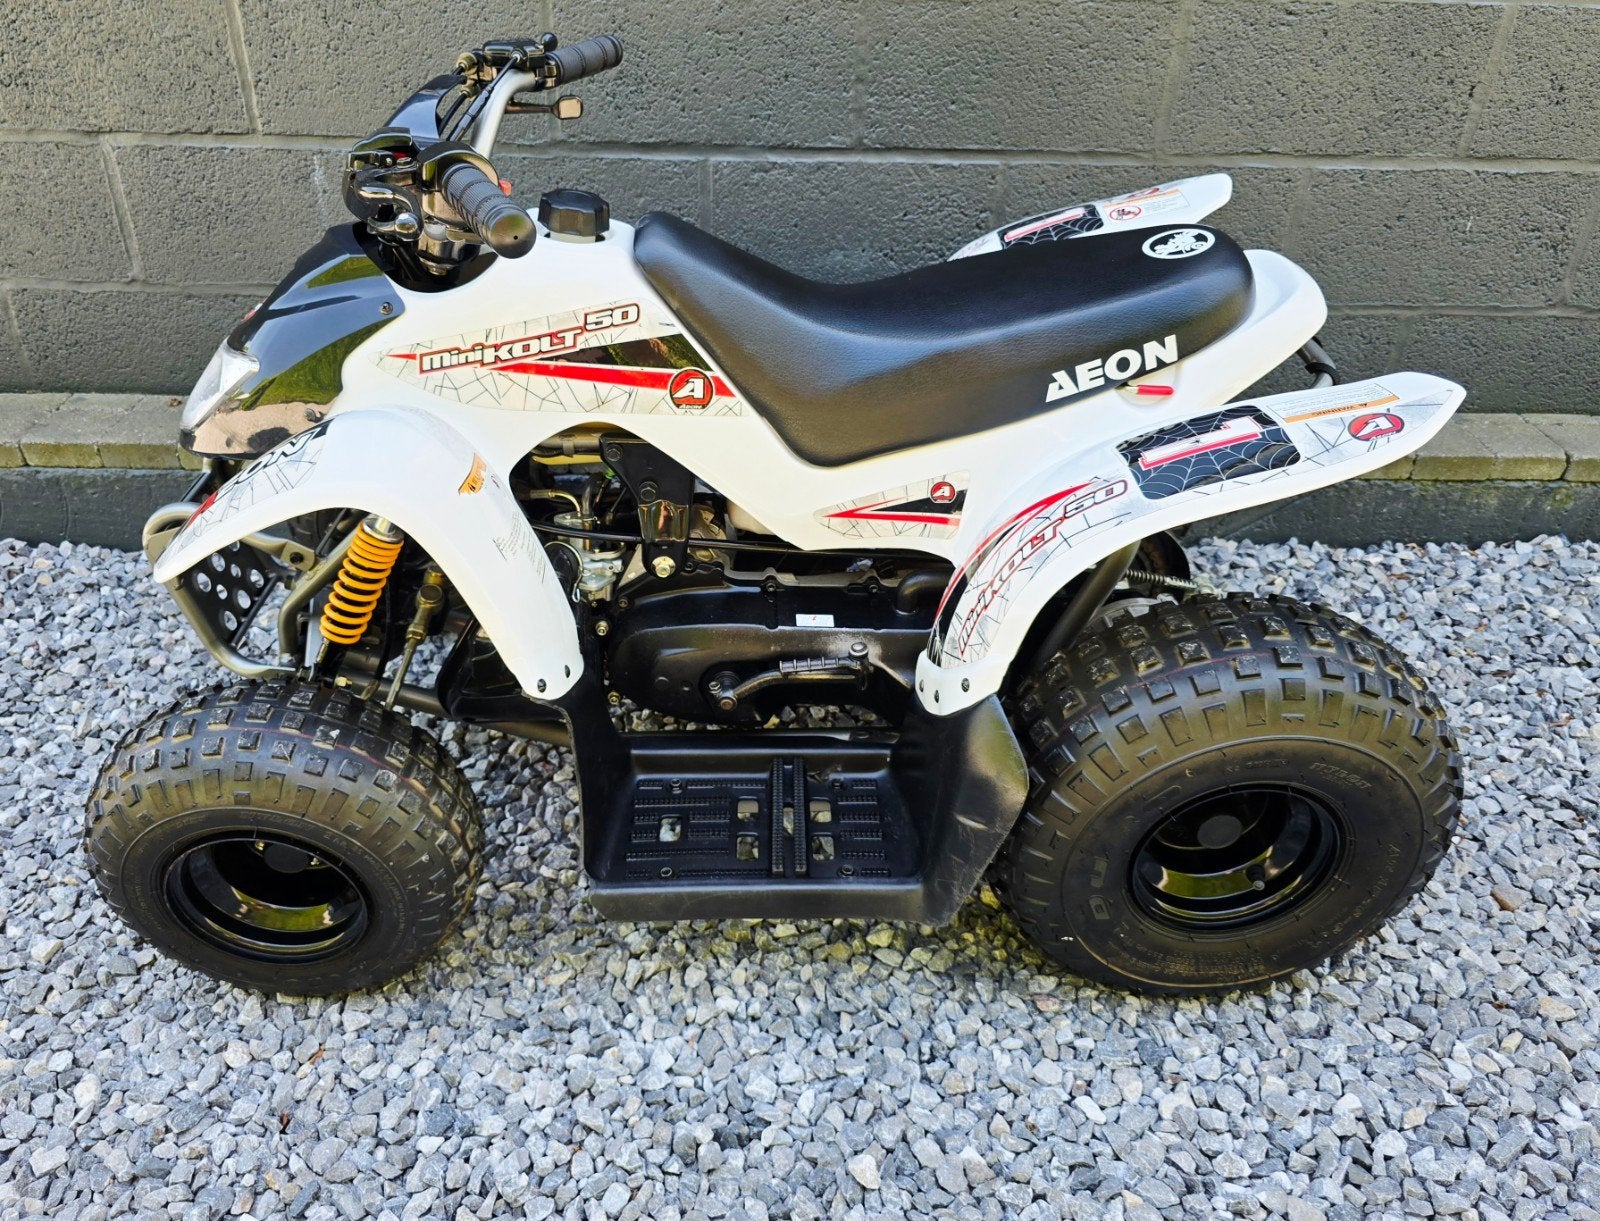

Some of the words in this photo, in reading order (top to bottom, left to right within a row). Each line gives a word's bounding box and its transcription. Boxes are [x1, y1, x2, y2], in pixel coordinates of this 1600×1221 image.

[584, 302, 641, 331] 50
[1045, 334, 1179, 403] AEON
[1063, 479, 1129, 519] 50
